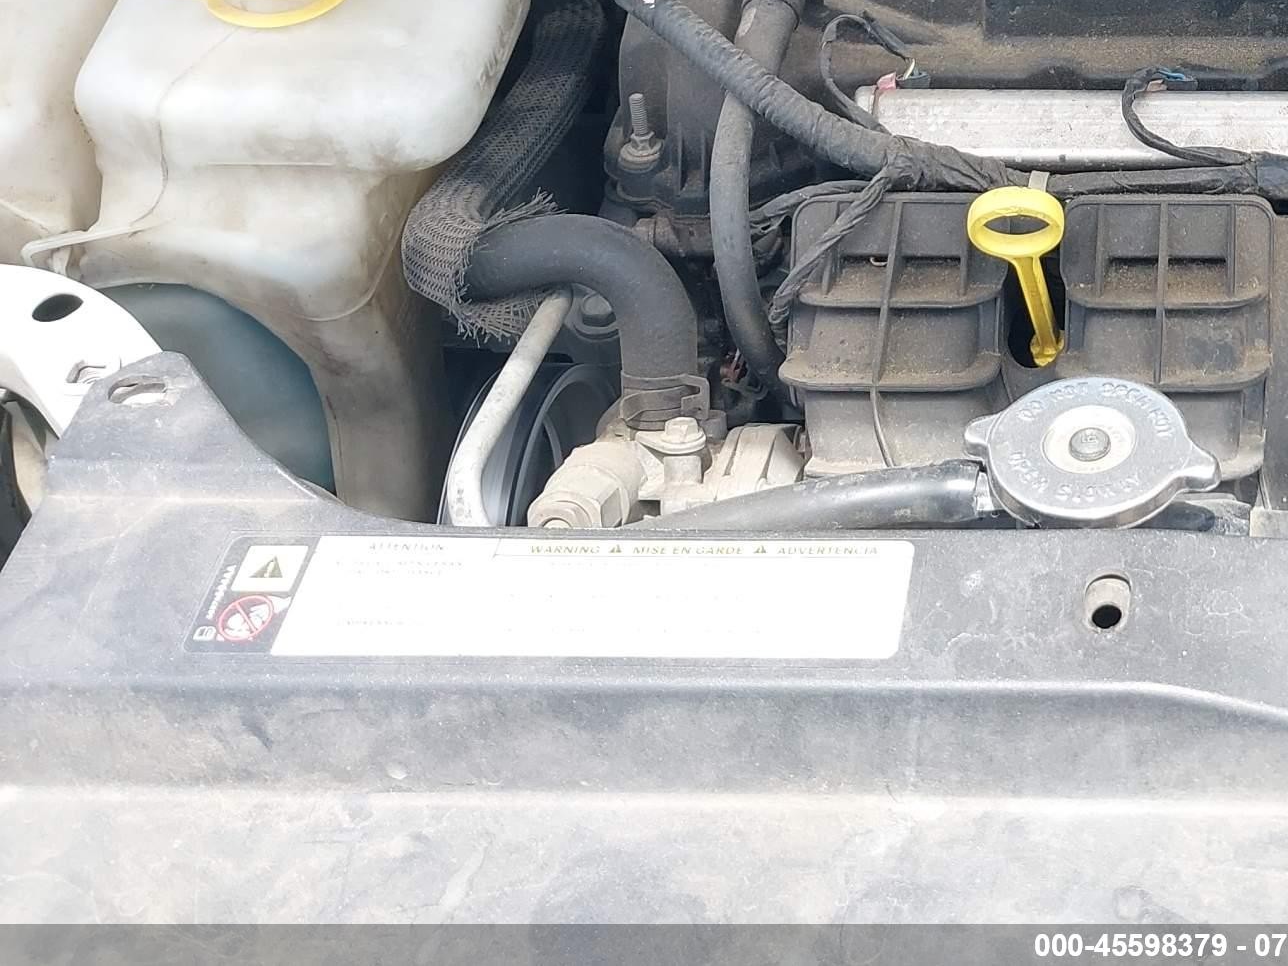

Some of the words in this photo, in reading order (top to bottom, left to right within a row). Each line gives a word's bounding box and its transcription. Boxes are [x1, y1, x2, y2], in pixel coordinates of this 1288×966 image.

[530, 544, 601, 554] WARNING
[632, 545, 668, 555] MISE
[672, 545, 691, 555] EN
[695, 545, 745, 555] GARDE
[776, 545, 880, 555] ADVERTENCIA
